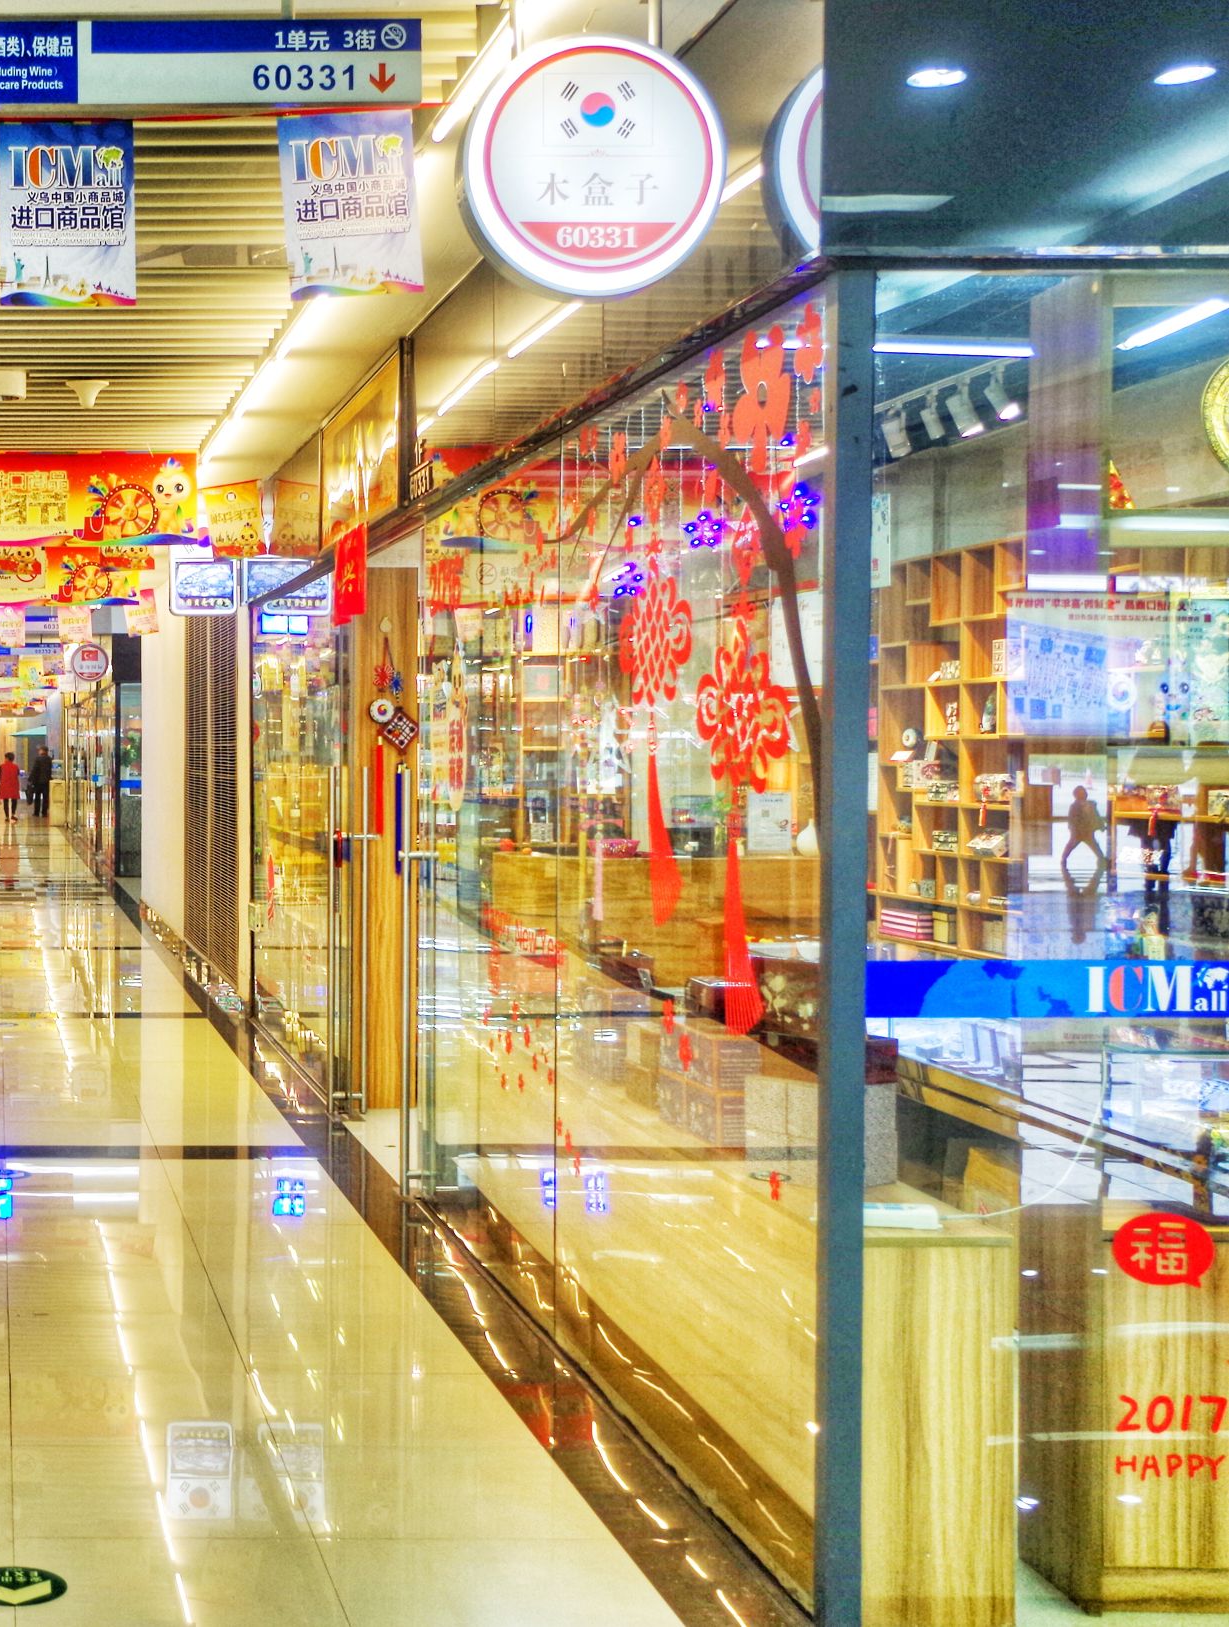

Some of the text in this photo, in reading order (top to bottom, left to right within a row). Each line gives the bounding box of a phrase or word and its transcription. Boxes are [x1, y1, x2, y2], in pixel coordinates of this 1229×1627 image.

[274, 29, 376, 51] 1单元 3街
[21, 80, 64, 90] Products
[252, 64, 355, 91] 60331
[26, 191, 125, 205] 义乌中国小商品城
[310, 179, 407, 197] 义乌中国小商品城
[537, 171, 659, 207] 木盒子
[11, 205, 125, 231] 进口商品馆
[295, 193, 408, 223] 进口商品馆
[555, 226, 639, 250] 60331
[1129, 1221, 1189, 1276] 福
[1115, 1394, 1228, 1434] 2017
[1114, 1454, 1225, 1481] HAPPY
